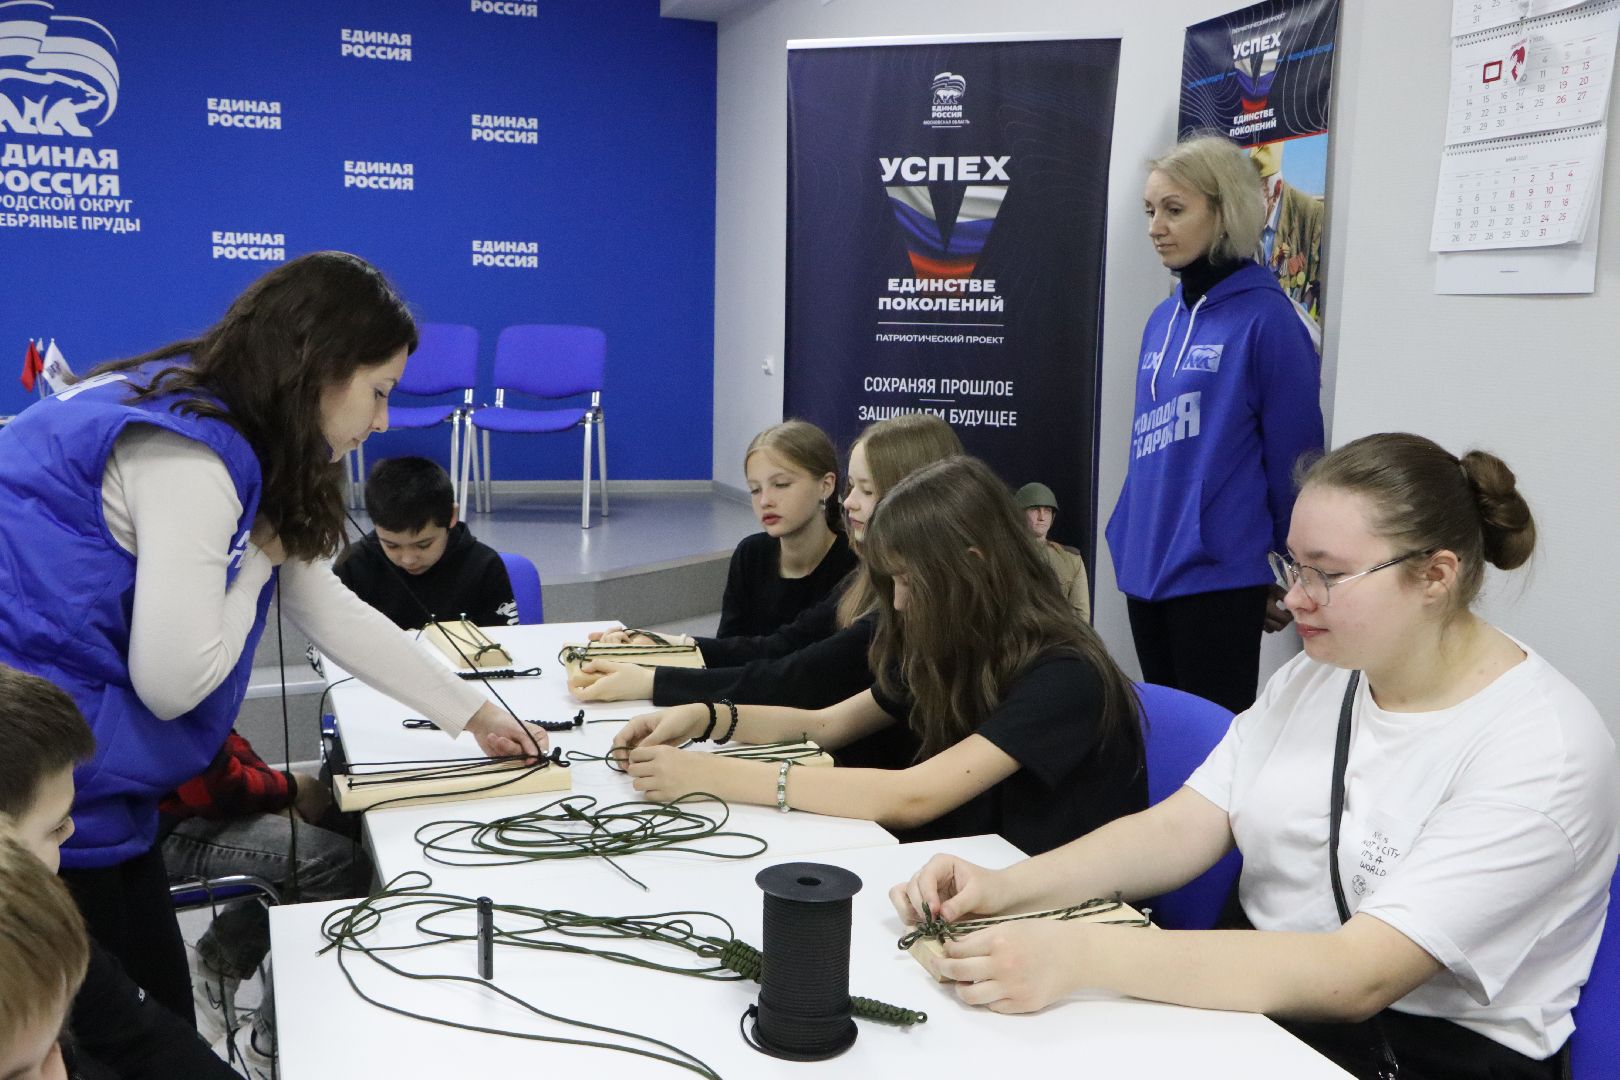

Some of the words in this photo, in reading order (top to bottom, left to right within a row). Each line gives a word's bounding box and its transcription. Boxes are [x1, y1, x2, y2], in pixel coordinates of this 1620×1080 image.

[470, 0, 538, 17] РОССИЯ
[341, 29, 412, 46] ЕДИНАЯ
[1232, 31, 1282, 60] УСПЕХ
[341, 44, 412, 61] РОССИЯ
[207, 98, 281, 114] ЕДИНАЯ
[208, 113, 282, 130] РОССИЯ
[471, 114, 538, 130] ЕДИНАЯ
[931, 111, 963, 119] РОССИЯ
[1233, 107, 1275, 125] ЕДИНСТВЕ
[1229, 117, 1277, 137] ПОКОЛЕНИЙ
[471, 128, 538, 144] РОССИЯ
[0, 143, 119, 170] ДИНАЯ
[344, 160, 413, 176] ЕДИНАЯ
[879, 156, 1011, 182] УСПЕХ
[0, 169, 120, 197] ОССИЯ
[344, 174, 414, 190] РОССИЯ
[0, 193, 76, 212] ОДСКОЙ
[79, 197, 133, 213] ОКРУГ
[0, 212, 79, 230] ЕБРЯНЫЕ
[81, 216, 141, 235] ПРУДЫ
[212, 231, 285, 246] ЕДИНАЯ
[472, 240, 539, 254] ЕДИНАЯ
[212, 245, 286, 261] РОССИЯ
[472, 253, 539, 268] РОССИЯ
[887, 278, 996, 294] ЕДИНСТВЕ
[878, 295, 1004, 312] ПОКОЛЕНИЙ
[876, 333, 964, 343] ПАТРИОТИЧЕСКИЙ
[966, 335, 1004, 344] ПРОЕКТ
[864, 377, 936, 393] СОХРАНЯЯ
[940, 379, 1014, 396] ПРОШЛОЕ
[950, 408, 1018, 428] БУДУЩЕЕ
[1375, 855, 1384, 864] A
[1381, 846, 1401, 858] CITY
[1359, 860, 1387, 877] WORLD
